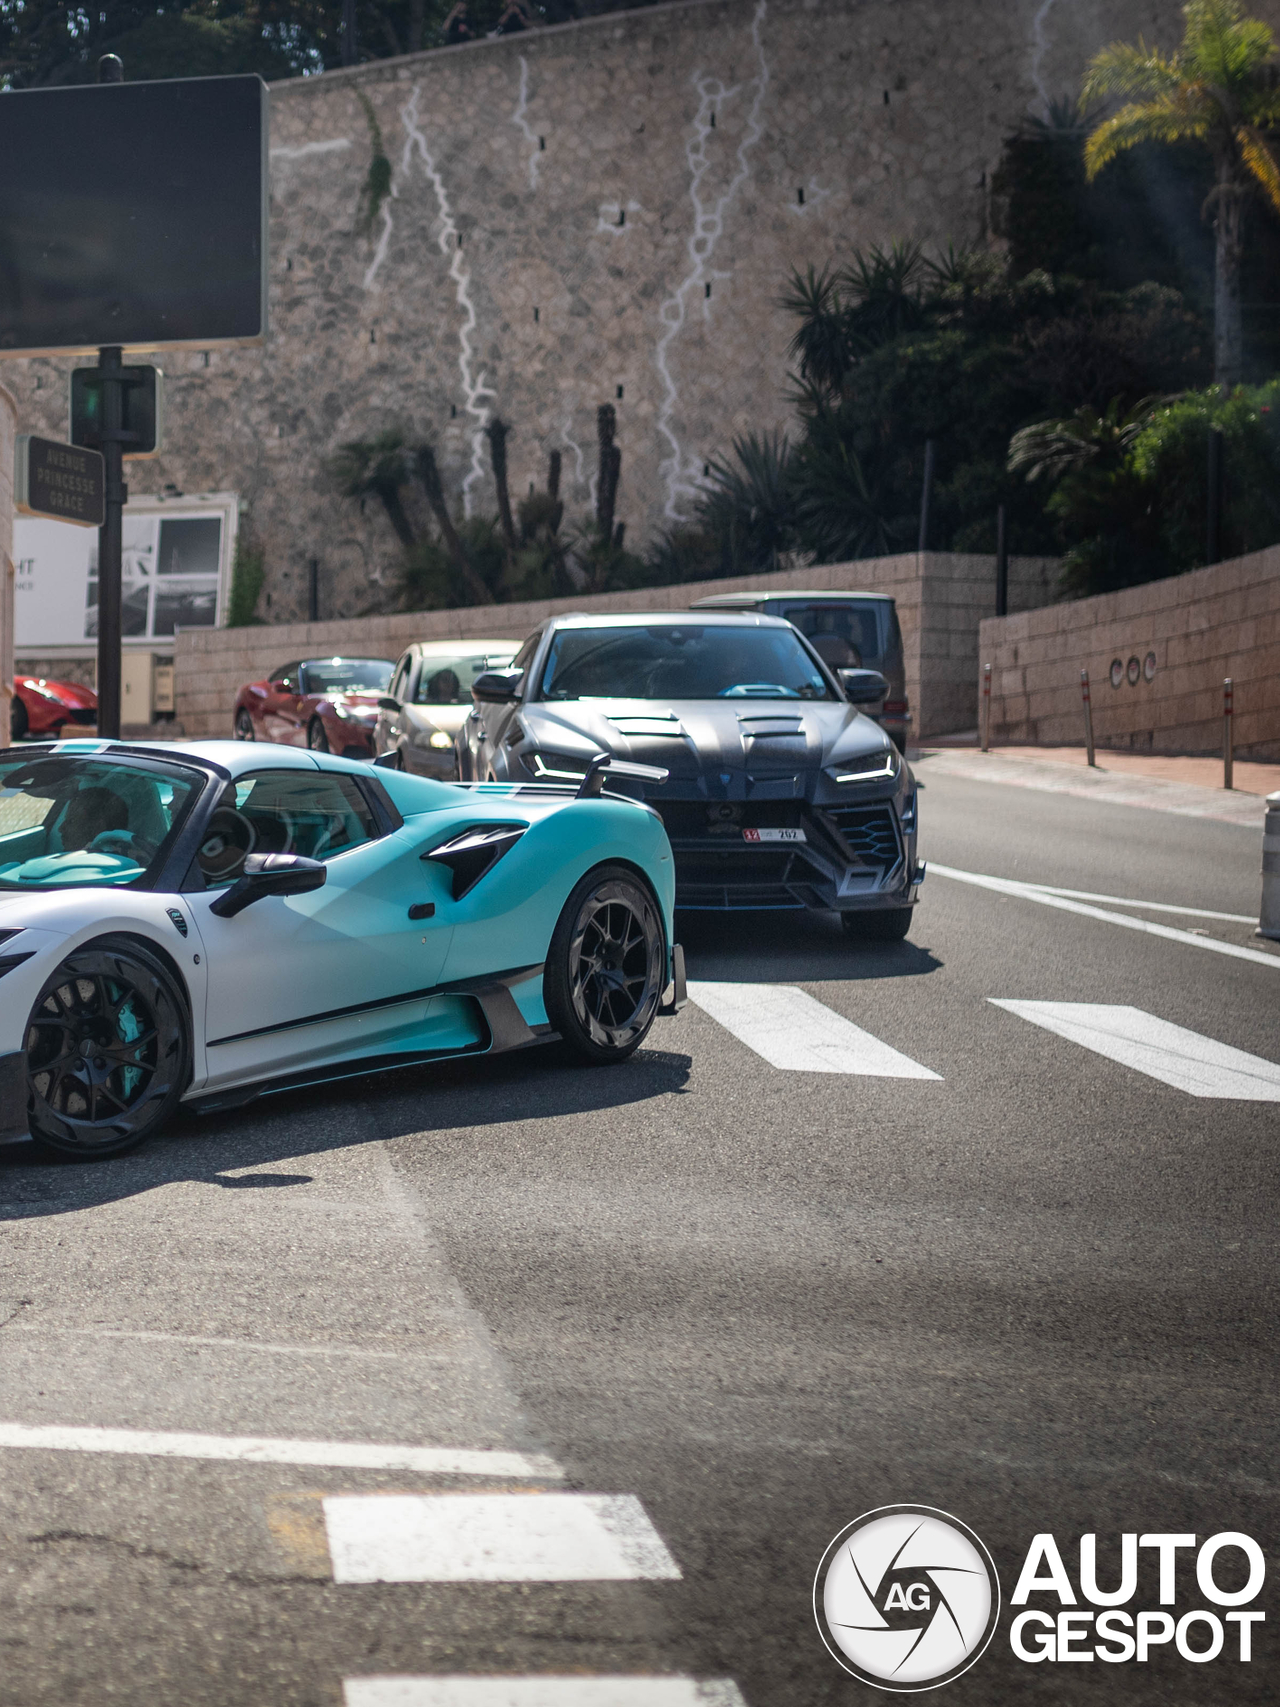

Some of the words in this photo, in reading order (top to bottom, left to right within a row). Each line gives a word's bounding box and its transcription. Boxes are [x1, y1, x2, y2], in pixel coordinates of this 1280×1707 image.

[47, 448, 86, 472] AVENUE
[37, 466, 95, 495] PRINCESSE
[50, 489, 83, 511] GRACE
